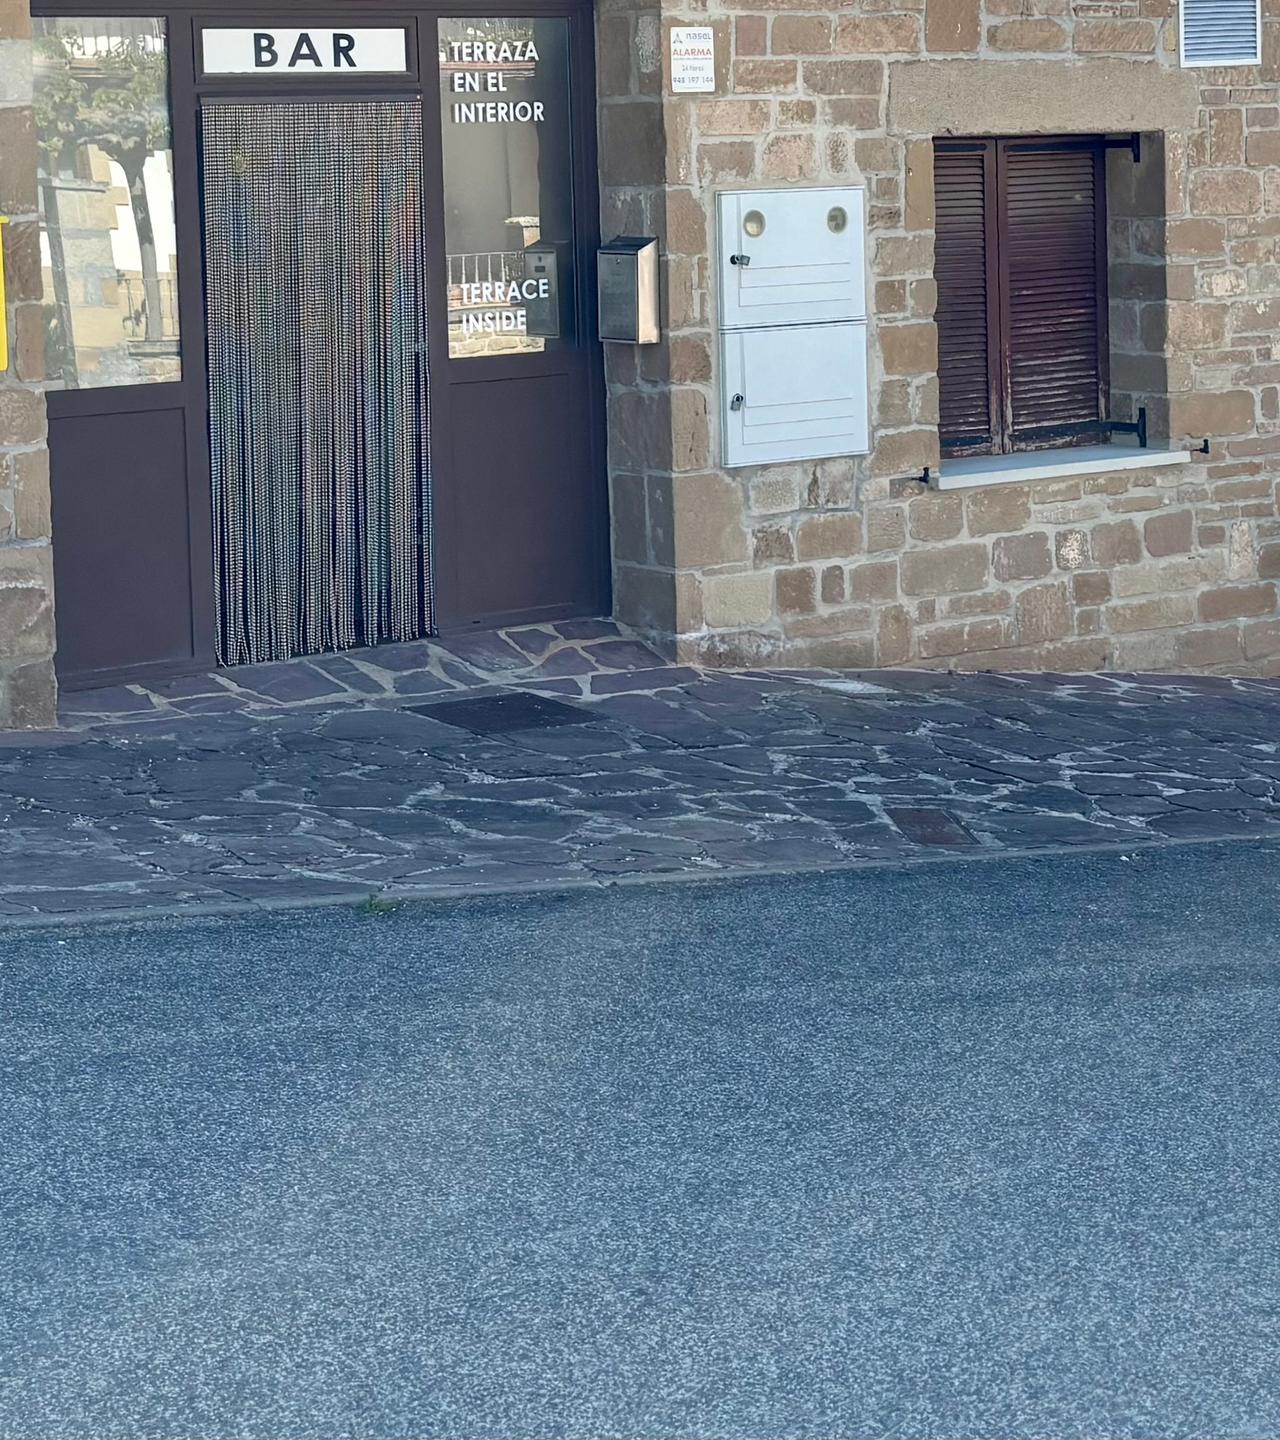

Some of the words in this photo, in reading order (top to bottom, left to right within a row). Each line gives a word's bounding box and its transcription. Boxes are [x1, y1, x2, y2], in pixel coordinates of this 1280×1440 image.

[253, 33, 357, 67] BAR
[451, 41, 539, 62] TERRAZA
[672, 47, 712, 56] ALARMA
[454, 71, 480, 92] EN
[487, 71, 507, 92] EL
[454, 101, 544, 123] INTERIOR
[461, 279, 549, 304] TERRACE
[462, 310, 526, 334] INSIDE
